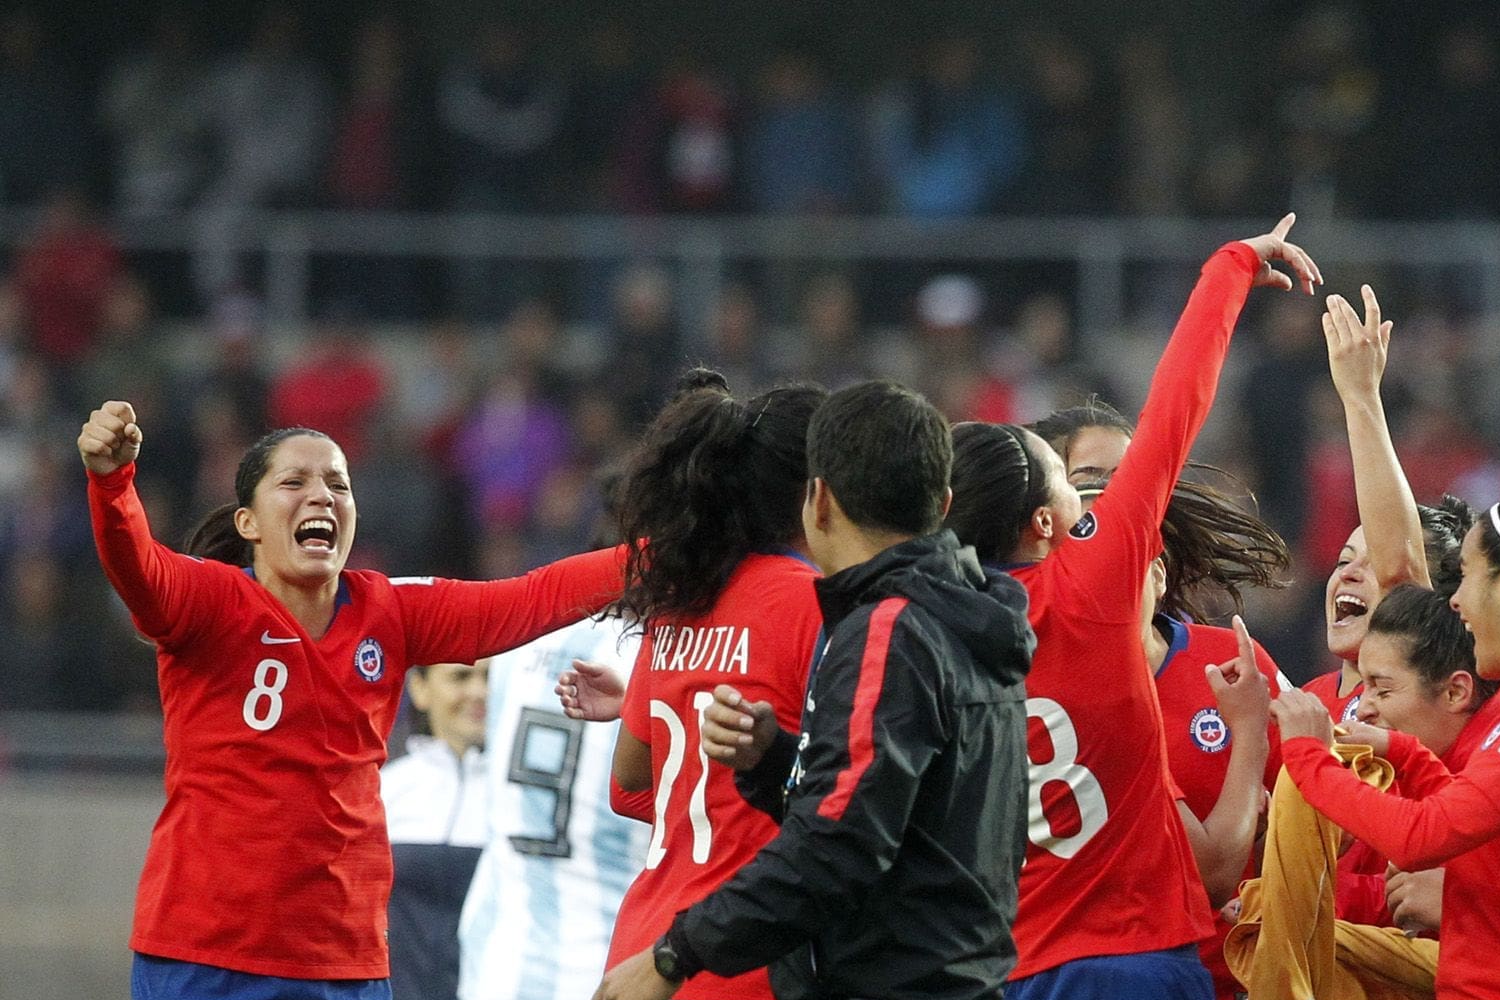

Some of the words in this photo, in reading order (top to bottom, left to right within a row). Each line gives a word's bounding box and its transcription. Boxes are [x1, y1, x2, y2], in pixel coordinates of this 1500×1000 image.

[243, 659, 288, 731] 8
[507, 706, 586, 859] 9
[647, 691, 715, 870] 21
